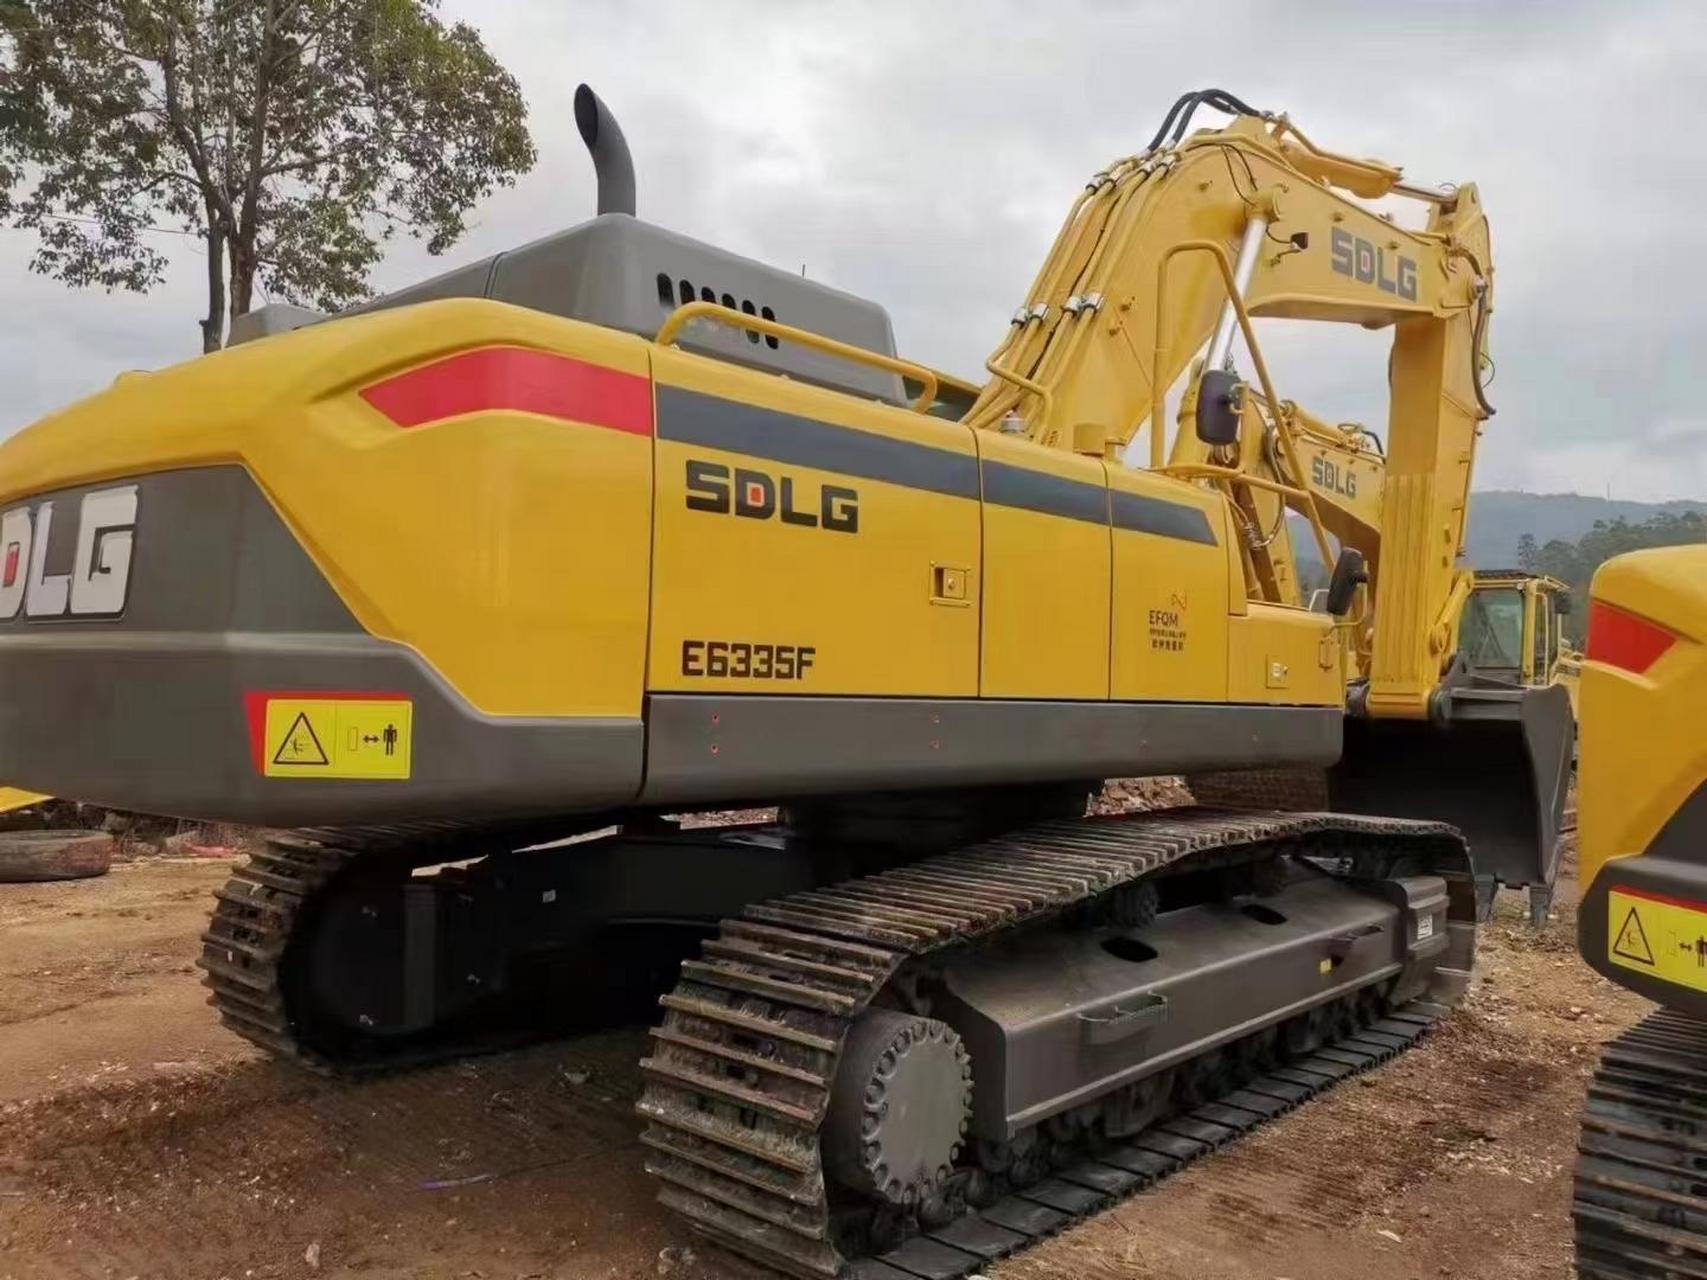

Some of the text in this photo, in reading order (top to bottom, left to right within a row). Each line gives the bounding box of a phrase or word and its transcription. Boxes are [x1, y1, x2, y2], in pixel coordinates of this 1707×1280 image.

[1331, 226, 1417, 302] SDLG
[685, 459, 858, 534] SDLG
[1312, 456, 1356, 500] SDLG
[1149, 610, 1178, 627] EFQM
[682, 640, 816, 680] E6335F
